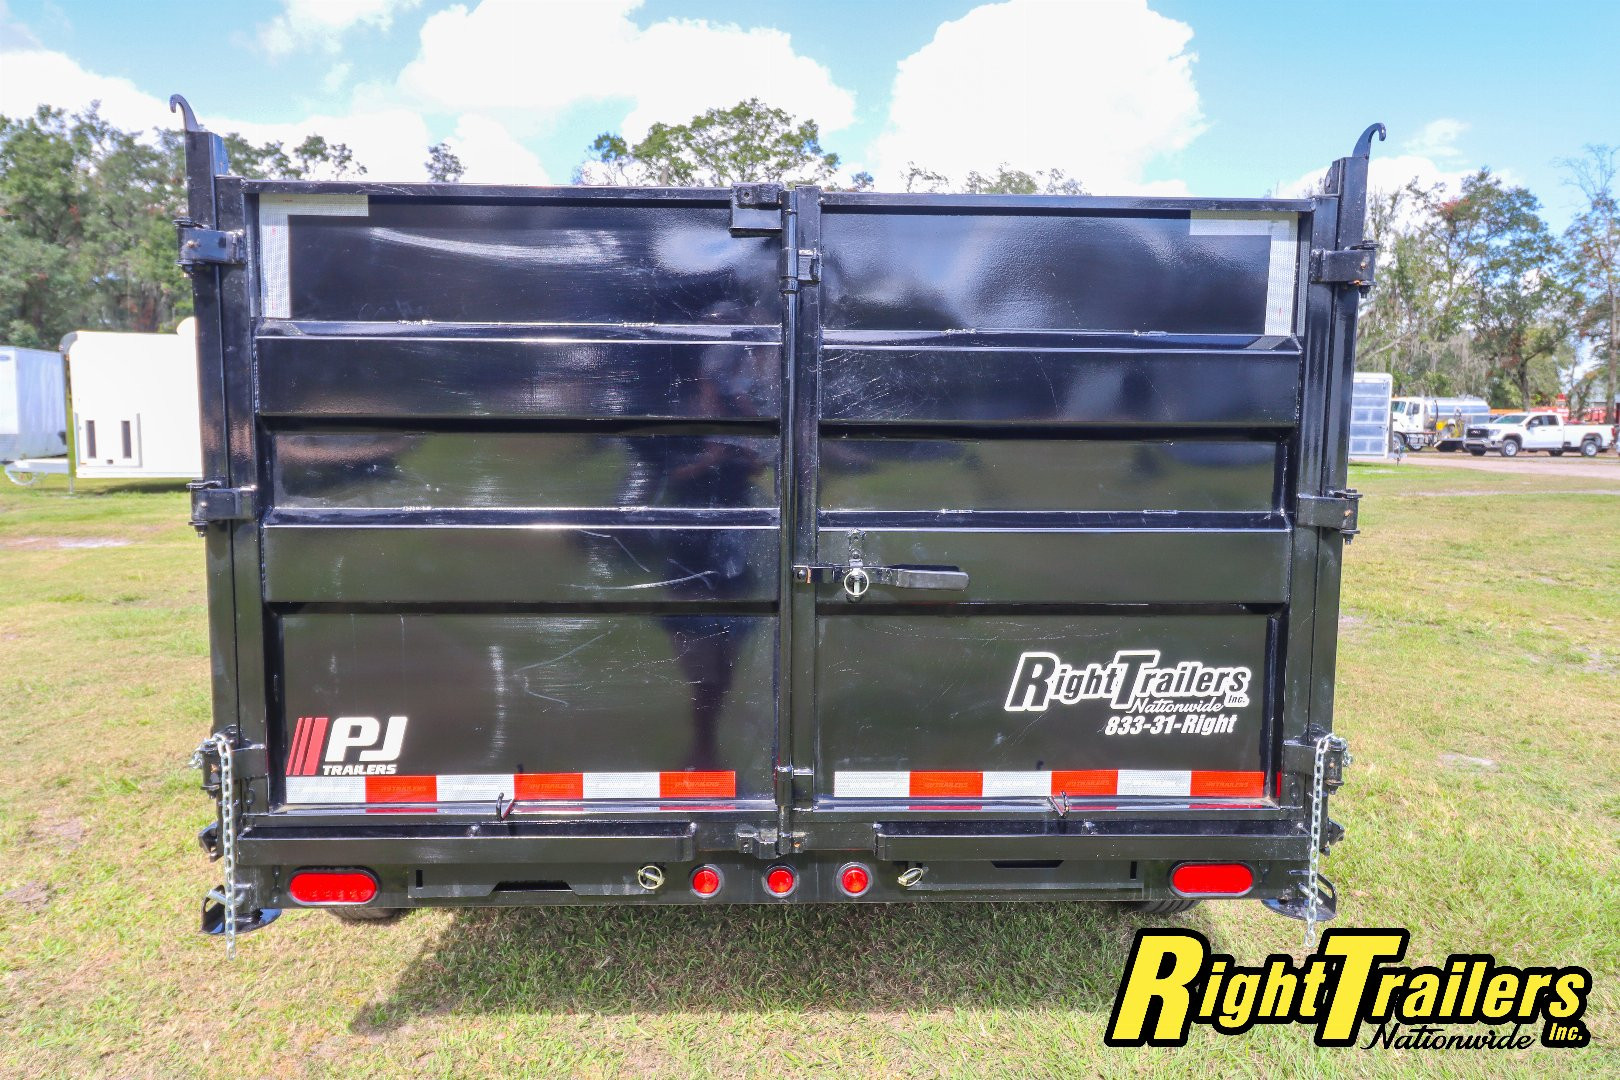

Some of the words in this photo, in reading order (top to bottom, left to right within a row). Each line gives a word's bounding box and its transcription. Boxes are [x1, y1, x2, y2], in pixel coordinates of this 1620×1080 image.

[1126, 697, 1225, 714] Nationwide
[1104, 714, 1238, 736] 833-31-Right
[324, 716, 408, 762] PJ
[322, 764, 398, 775] TRAILERS
